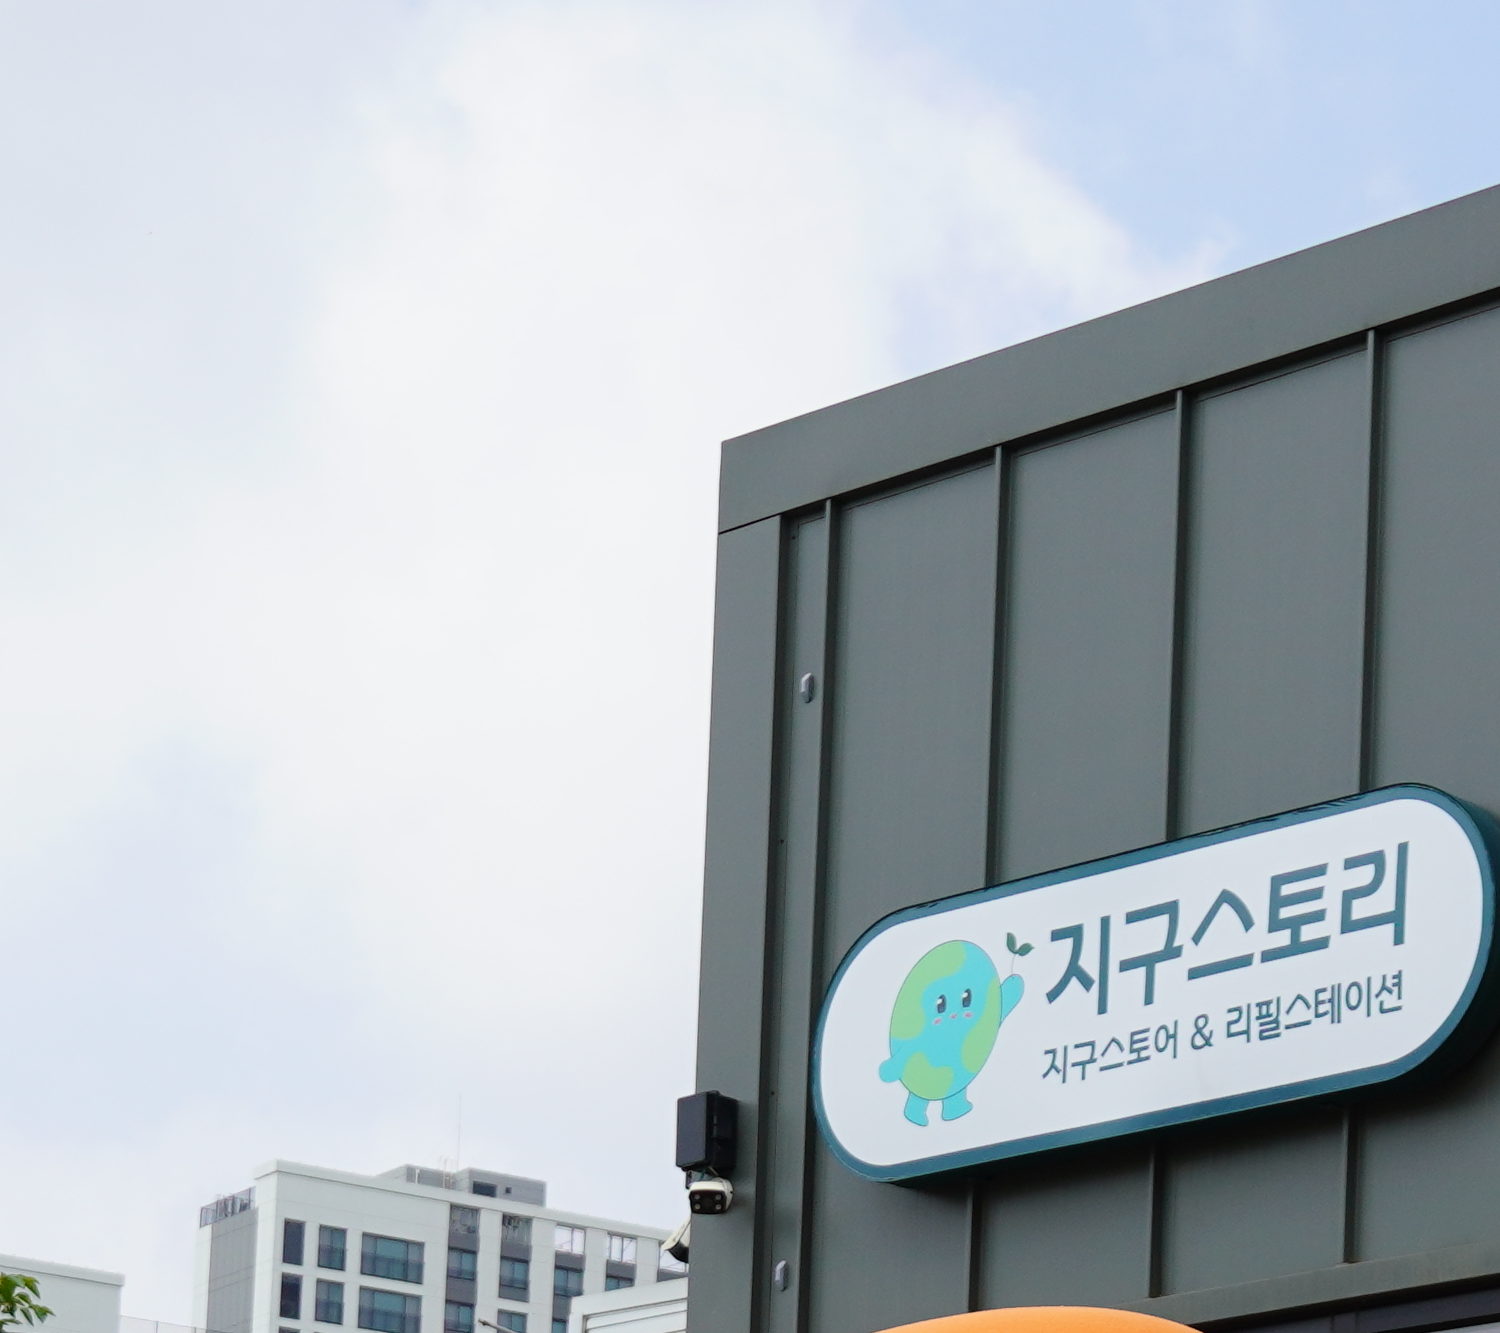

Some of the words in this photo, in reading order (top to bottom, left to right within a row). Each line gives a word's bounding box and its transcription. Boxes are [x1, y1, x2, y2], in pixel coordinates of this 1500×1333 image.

[1045, 840, 1411, 1016] 지구스토리
[1041, 1018, 1179, 1085] 지구스토어
[1190, 1014, 1215, 1051] &
[1225, 969, 1404, 1044] 리필스테이션
